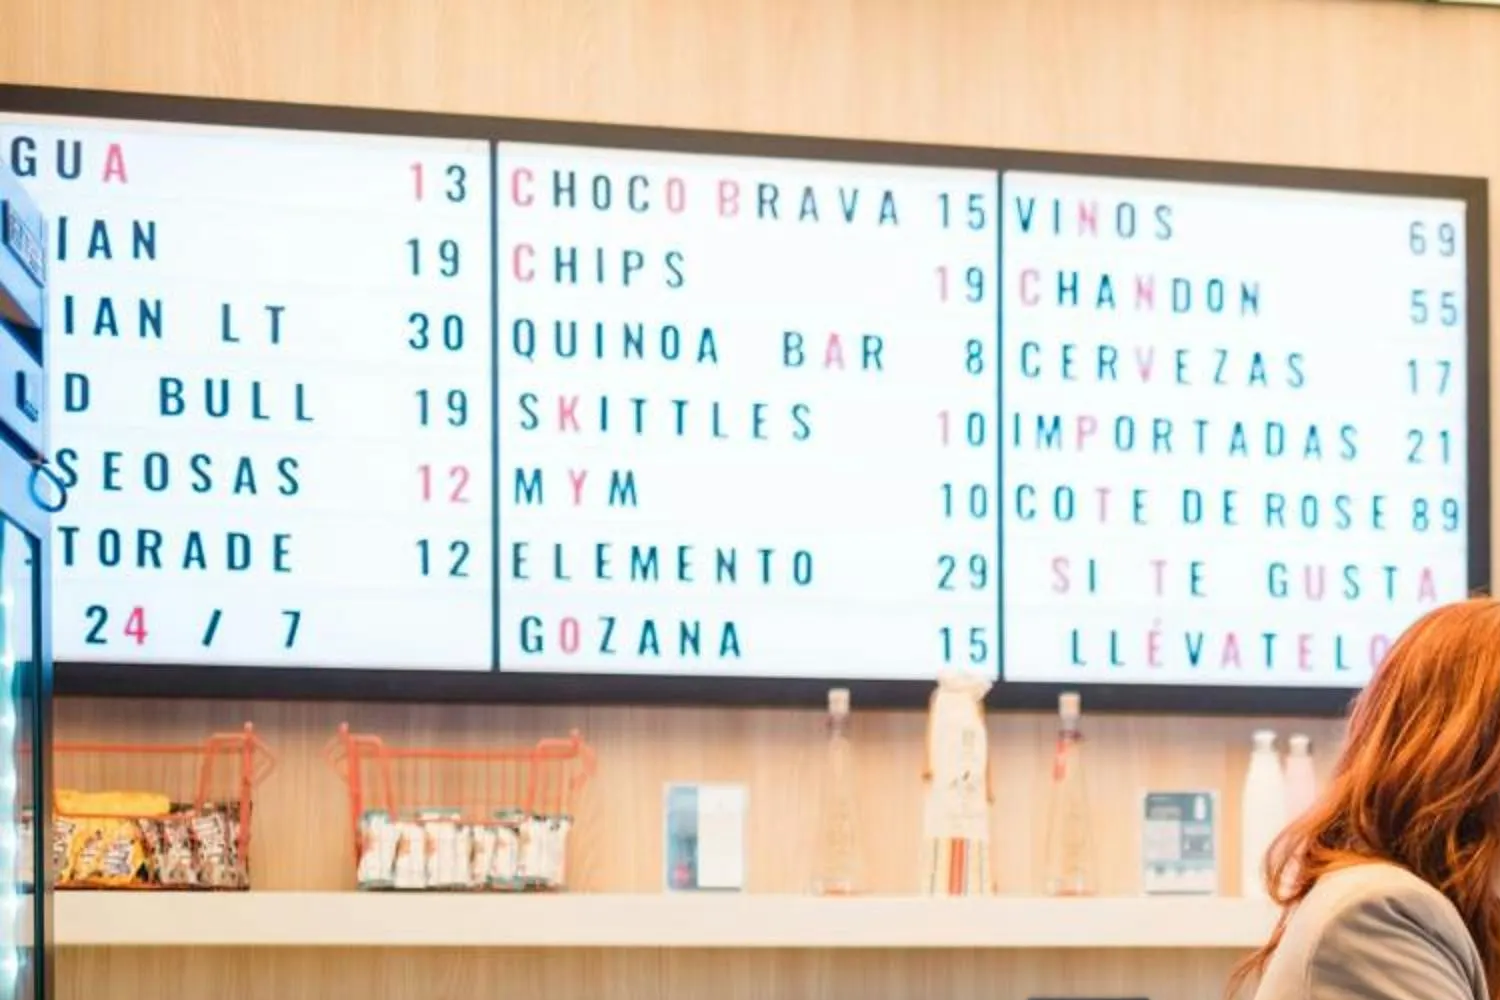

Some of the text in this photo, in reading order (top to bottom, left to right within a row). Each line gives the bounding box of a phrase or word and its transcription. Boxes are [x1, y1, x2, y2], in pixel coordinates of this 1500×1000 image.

[10, 135, 467, 203] GUA 13
[512, 168, 986, 231] CHOCO BRAVA 15
[1014, 196, 1456, 257] VINOS 69
[57, 216, 157, 261] IAN
[407, 238, 460, 278] 19
[513, 244, 985, 304] CHIPS 19
[64, 294, 464, 352] IAN LT 30
[1019, 269, 1457, 326] CHANDON 55
[512, 318, 984, 375] QUINOA BAR 8
[1020, 340, 1451, 394] CERVEZAS 17
[64, 372, 468, 427] D BULL 19
[518, 392, 987, 448] SKITTLES 10
[1013, 412, 1451, 464] IMPORTADAS 21
[55, 447, 469, 502] SEOSAS 12
[514, 467, 988, 519] MYM 10
[1014, 483, 1148, 524] COTE
[1411, 498, 1459, 532] 89
[57, 525, 470, 578] TORADE 12
[511, 541, 988, 590] ELEMENTO 29
[1051, 557, 1437, 602] SI TE GUSTA
[84, 604, 148, 646] 24
[283, 610, 301, 649] 7
[519, 615, 988, 664] GOZANA 15
